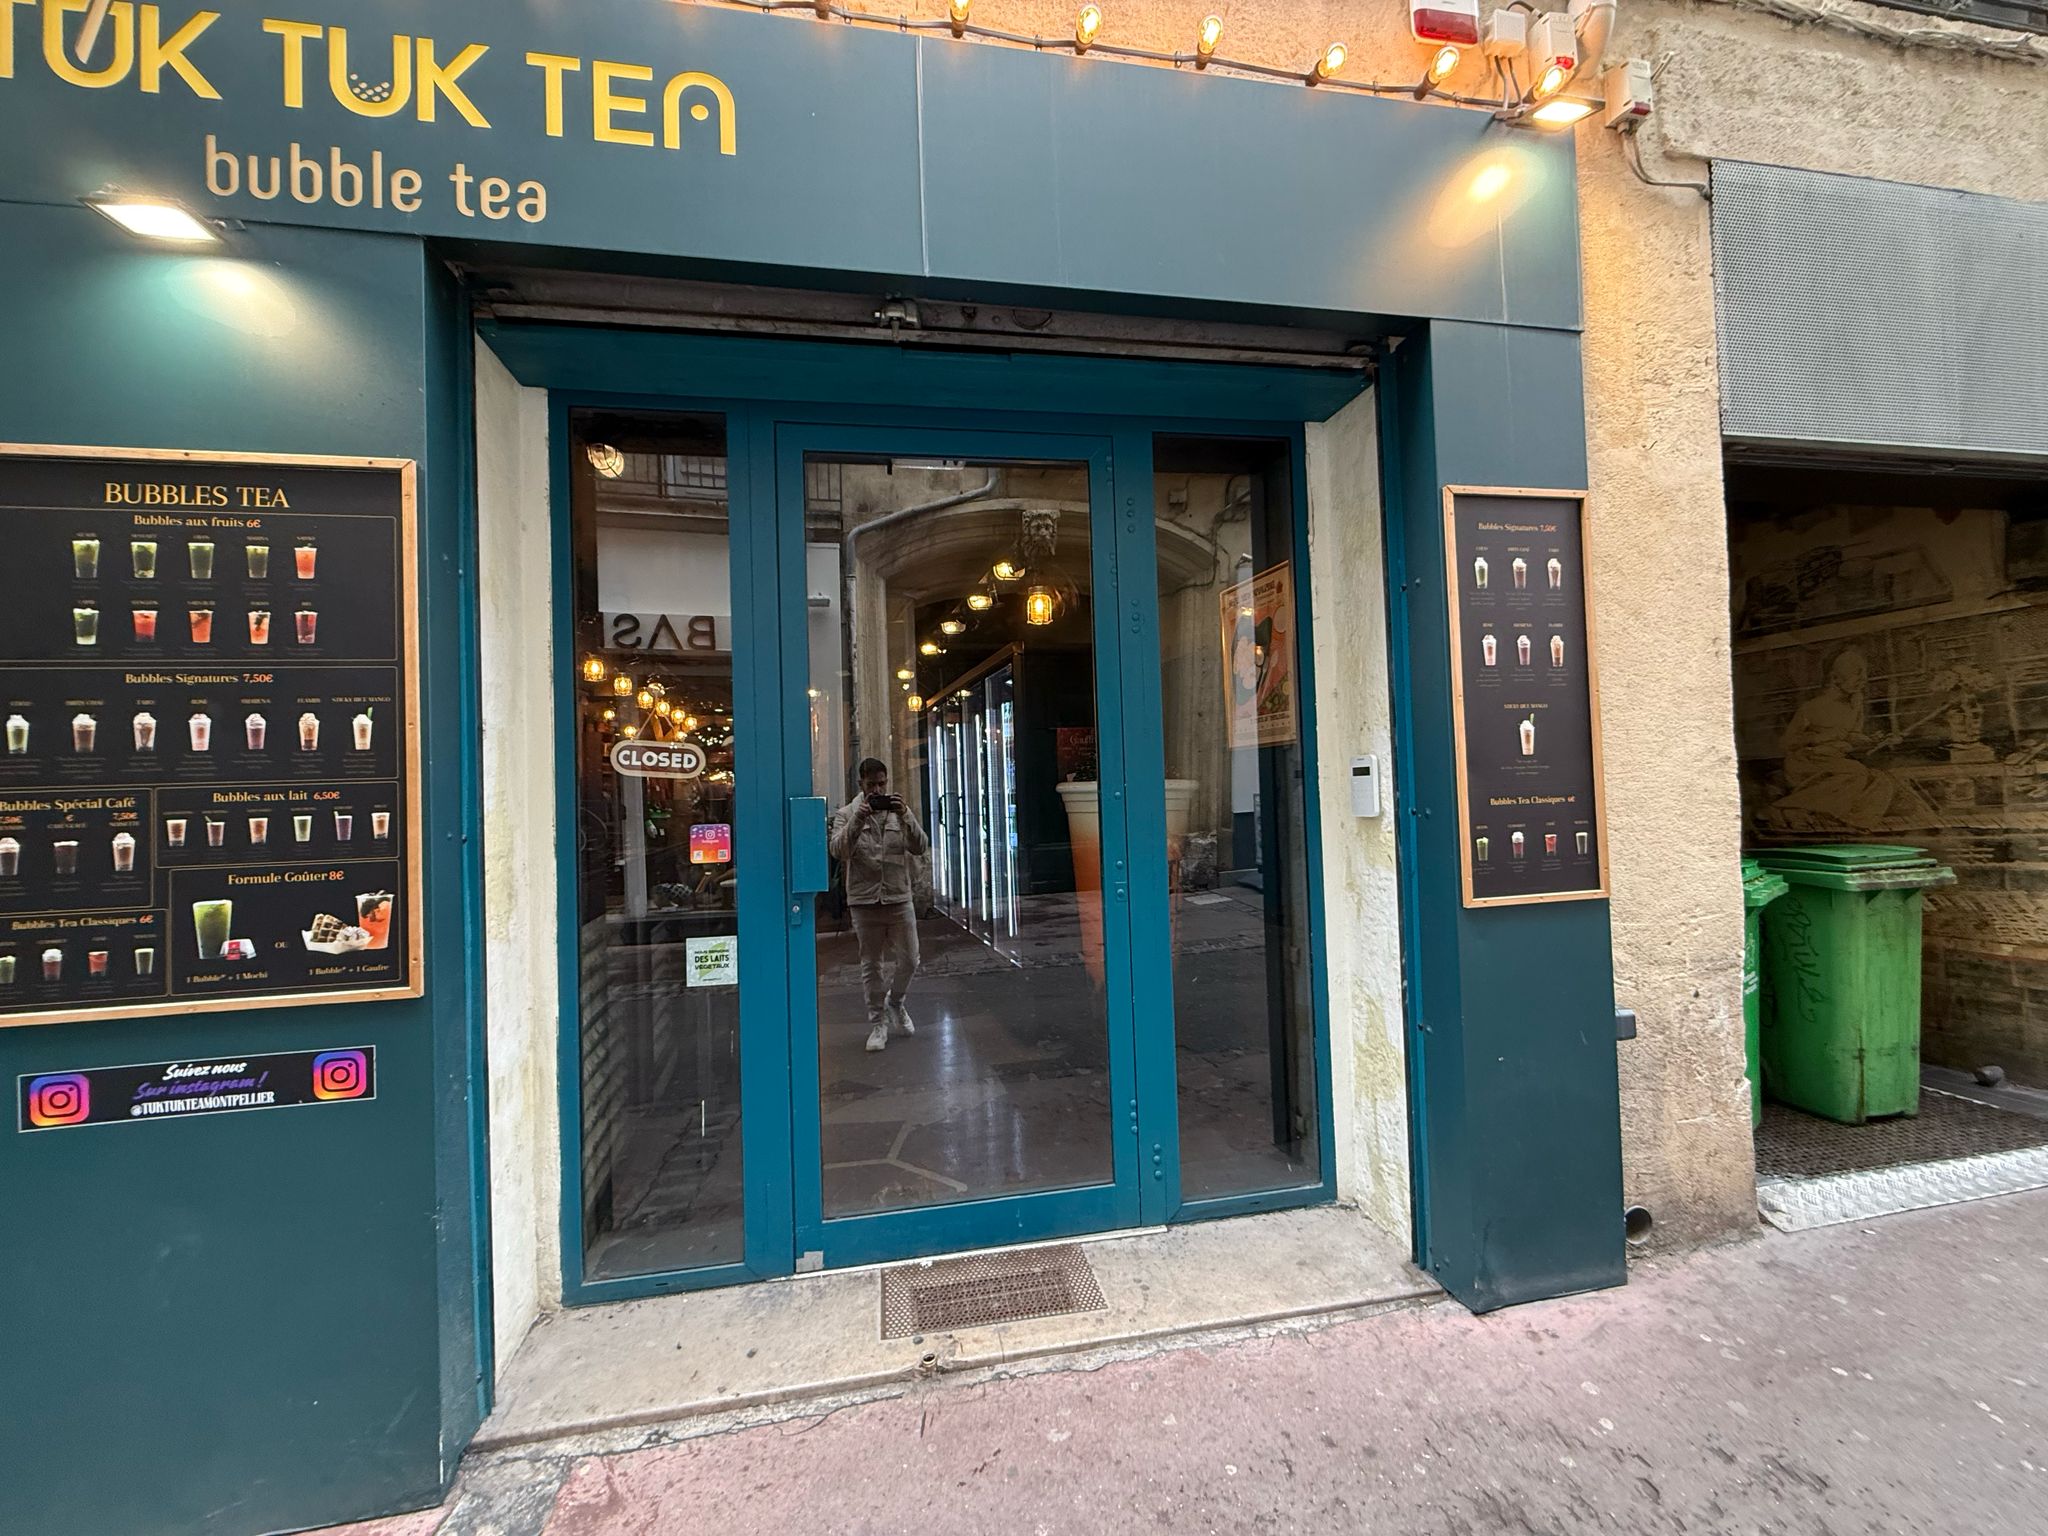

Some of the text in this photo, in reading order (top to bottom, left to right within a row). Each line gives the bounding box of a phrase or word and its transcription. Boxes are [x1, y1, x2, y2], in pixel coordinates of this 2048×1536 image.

[262, 18, 492, 129] TUK
[526, 52, 737, 155] TEA
[206, 134, 547, 224] bubble tea
[104, 482, 290, 508] BUBBLES TEA
[133, 514, 261, 528] Bubbles aux fruits 6€
[125, 673, 273, 685] Bubbles Signatures 7,50€
[618, 749, 697, 769] CLOSED
[0, 797, 136, 812] Bubbles Spécial Café
[213, 791, 340, 803] Bubbles aux lait 6,50€
[228, 870, 344, 885] Formule Goûter 8€
[12, 920, 55, 931] Bubbles
[58, 918, 78, 928] Tea
[80, 917, 136, 927] Classiques
[694, 954, 730, 963] DES LAITS
[162, 1062, 247, 1080] Suivez nous
[132, 1082, 168, 1100] Sur
[168, 1076, 256, 1097] instagram
[130, 1091, 275, 1116] @TUKTUKTEAMONTPELLIER
